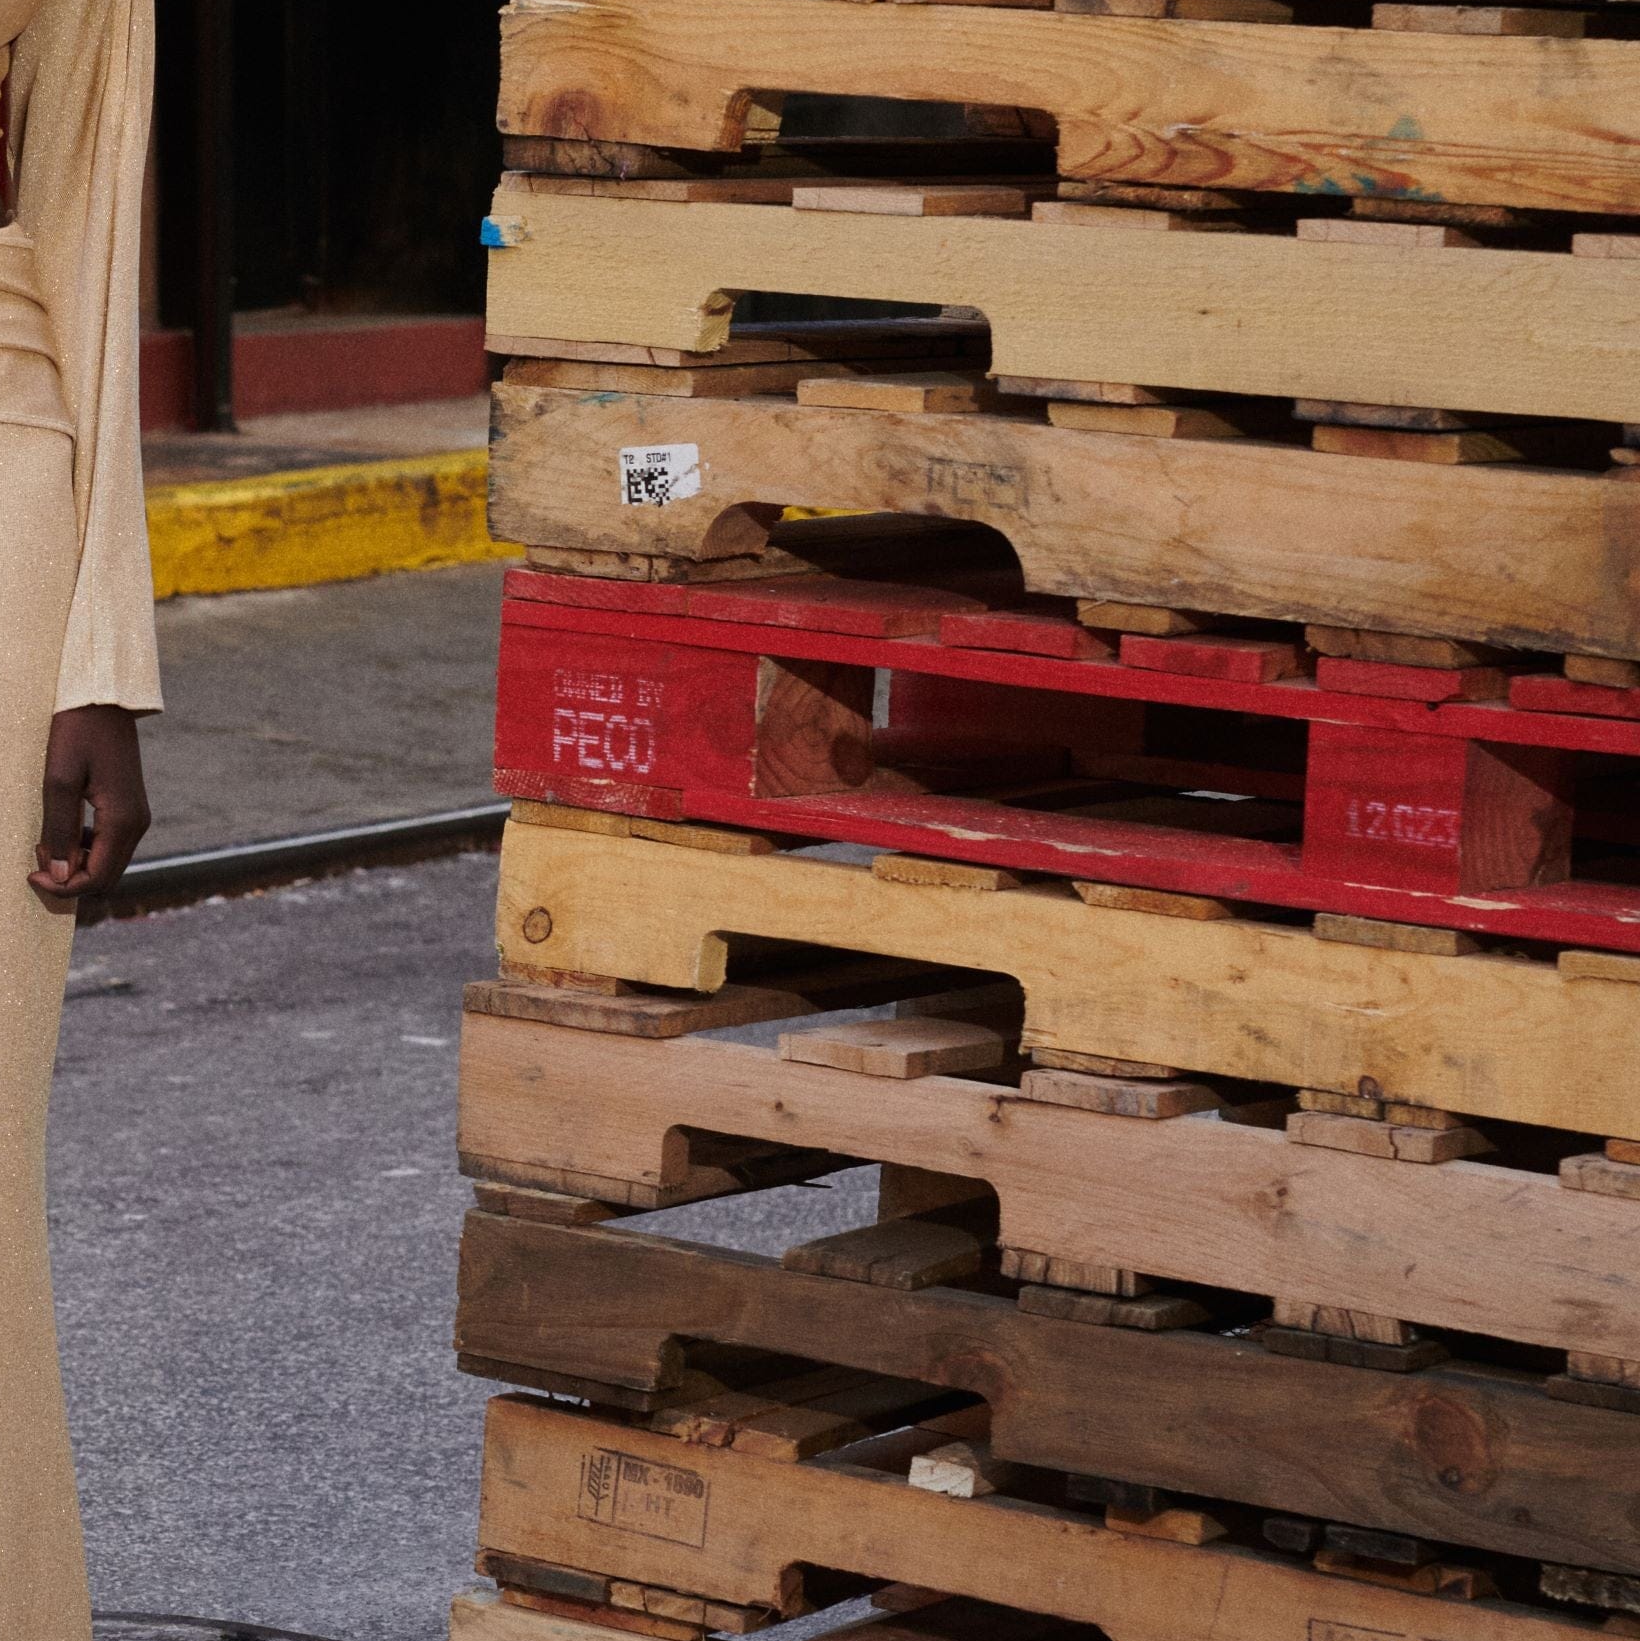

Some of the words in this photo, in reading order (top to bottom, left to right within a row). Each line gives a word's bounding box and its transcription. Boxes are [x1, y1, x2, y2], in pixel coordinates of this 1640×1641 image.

[623, 454, 634, 465] T2
[646, 452, 672, 464] STD#1
[553, 708, 656, 774] PECO
